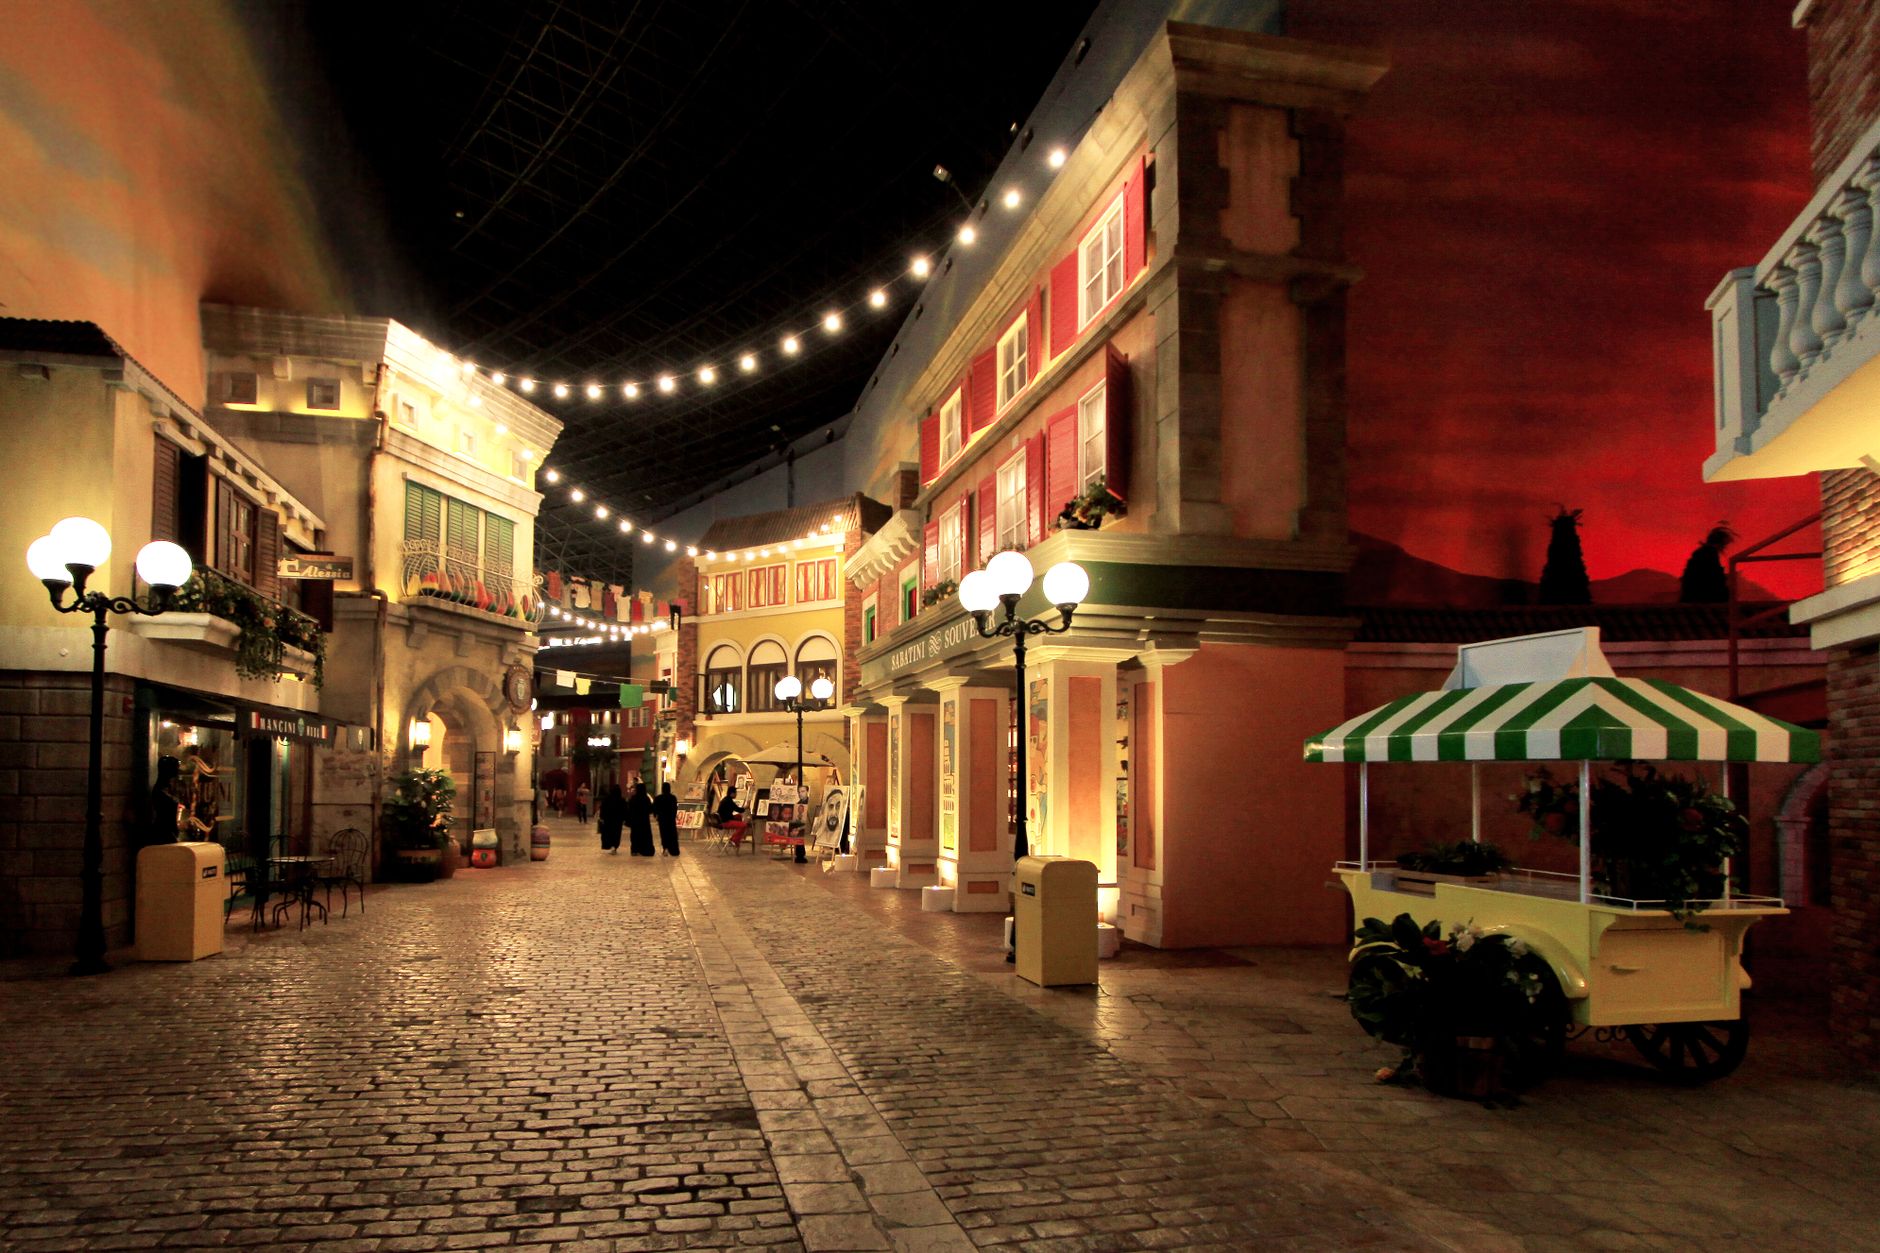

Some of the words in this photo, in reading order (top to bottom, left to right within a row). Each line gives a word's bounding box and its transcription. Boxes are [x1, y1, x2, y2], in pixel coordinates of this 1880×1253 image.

[301, 565, 351, 578] Alessia
[891, 641, 925, 671] SABATINI
[944, 609, 996, 649] SOUVER
